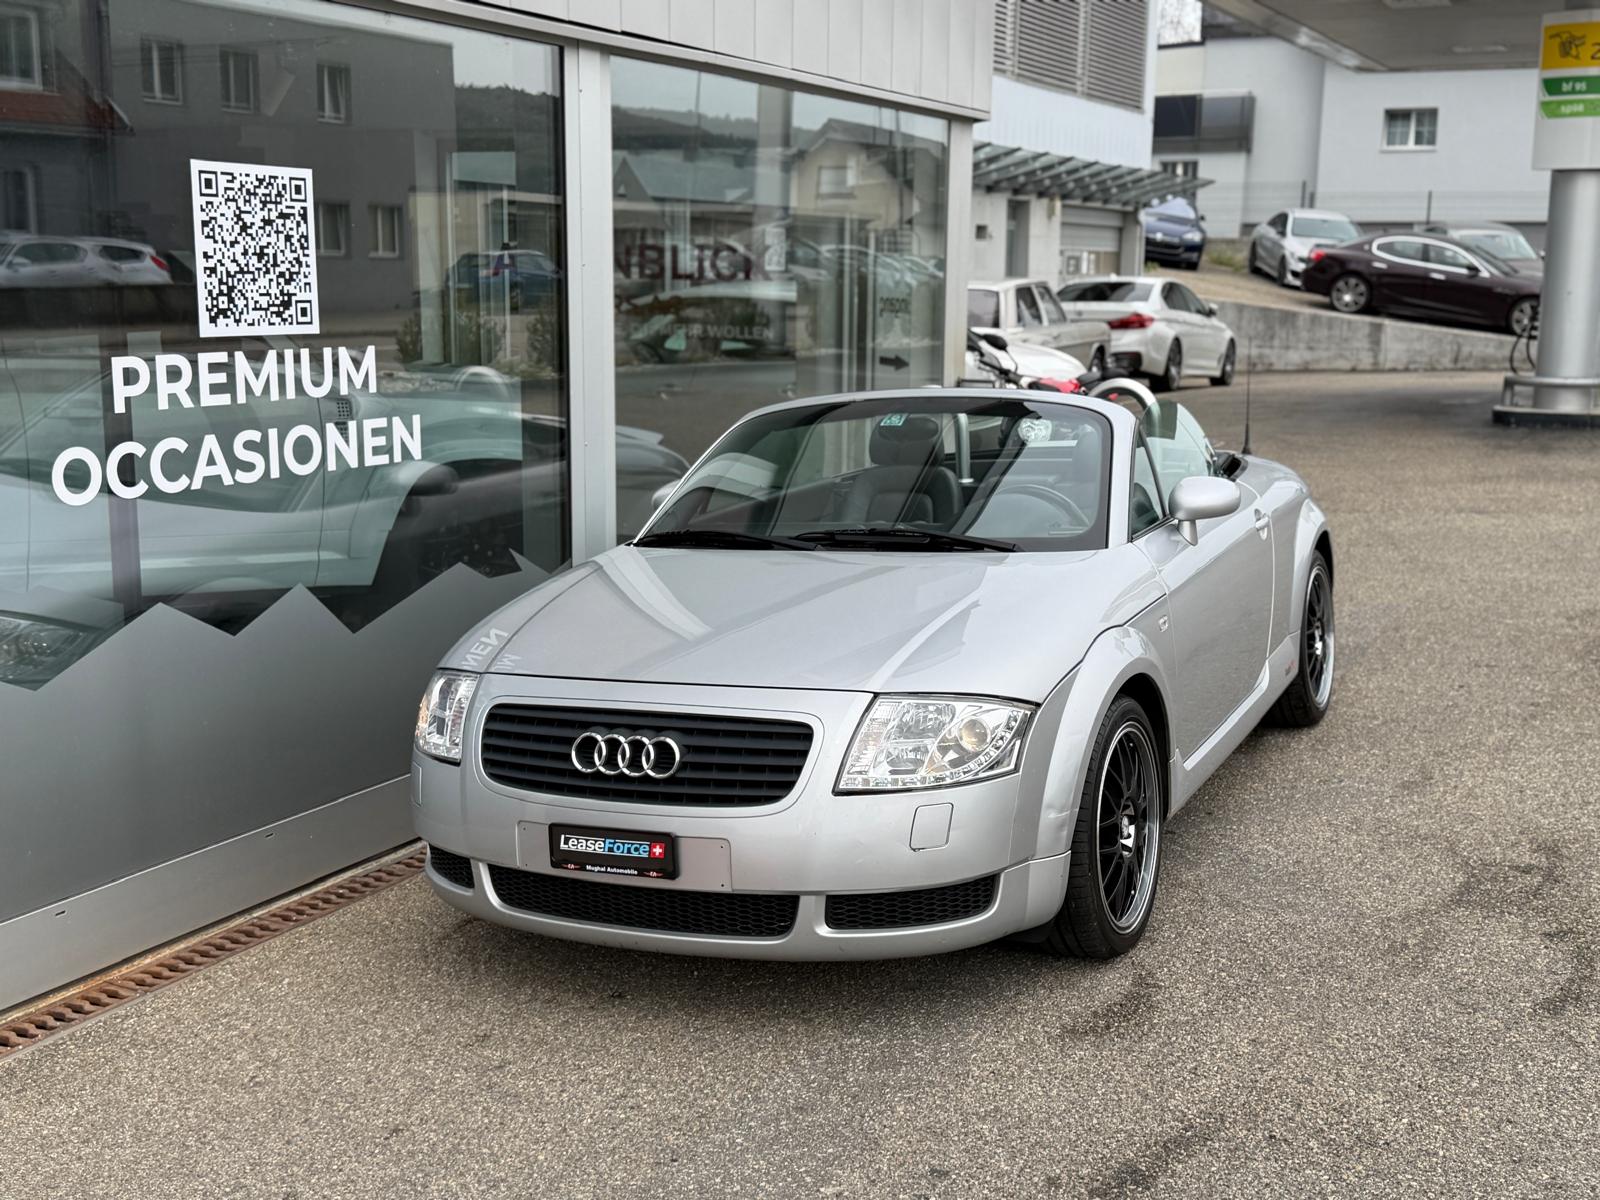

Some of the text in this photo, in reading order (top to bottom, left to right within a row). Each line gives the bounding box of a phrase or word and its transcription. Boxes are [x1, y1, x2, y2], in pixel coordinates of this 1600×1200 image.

[707, 324, 775, 340] WOLLEN
[111, 346, 377, 414] PREMIUM
[51, 414, 423, 506] OCCASIONEN
[560, 834, 650, 857] LeaseForce
[607, 866, 638, 875] Automobile
